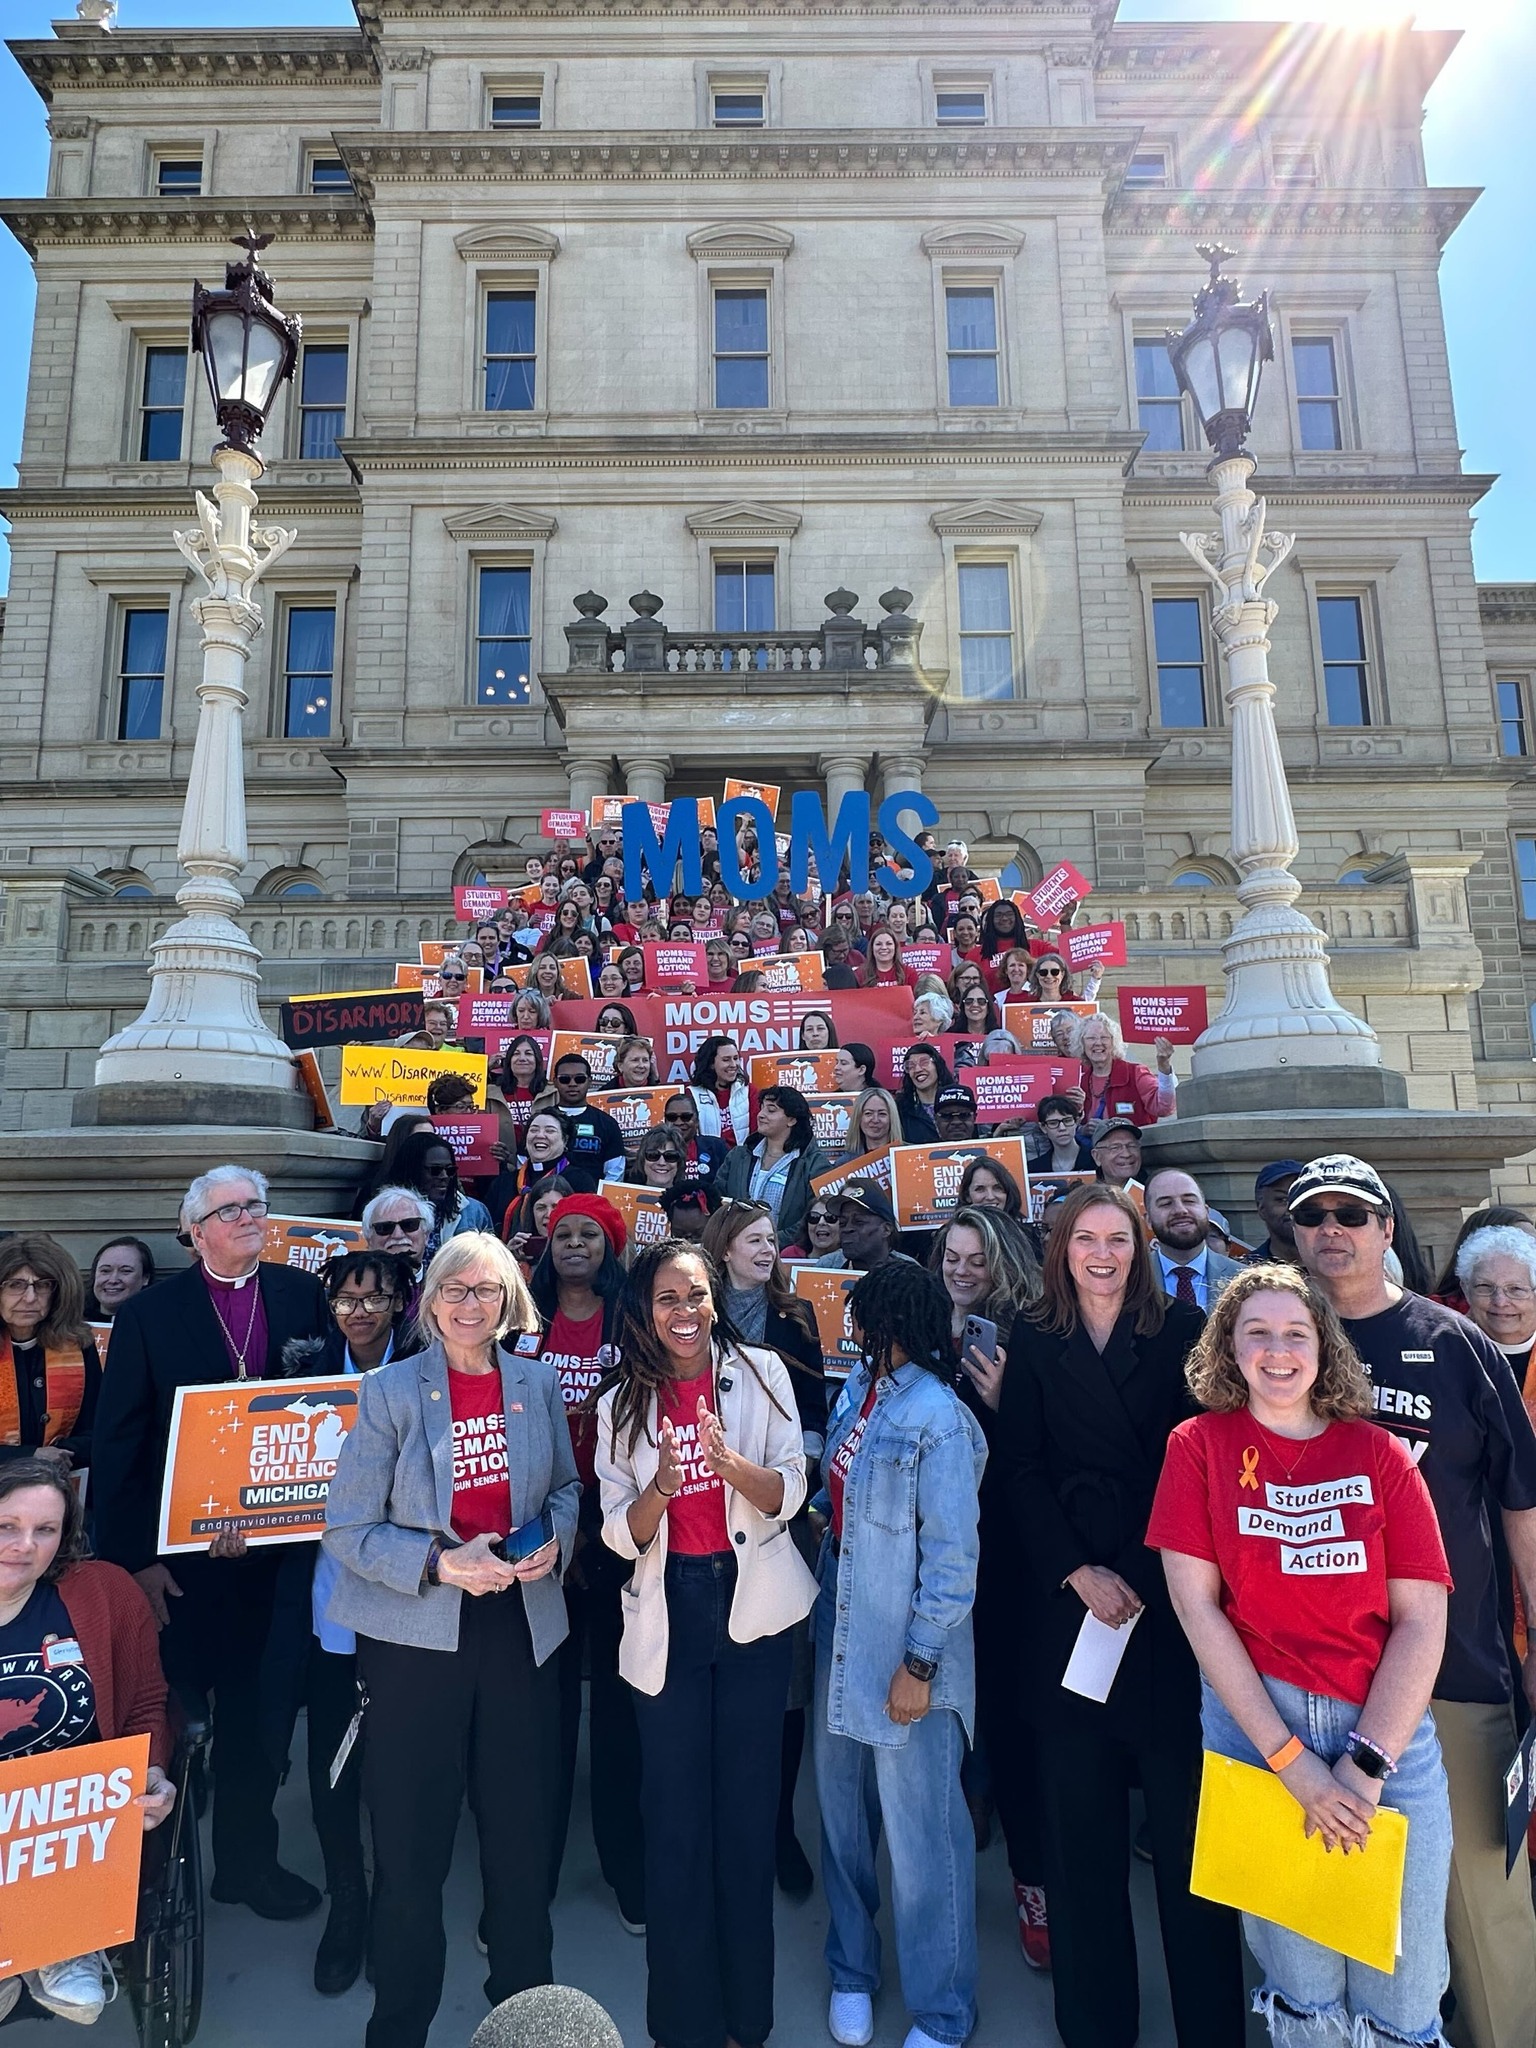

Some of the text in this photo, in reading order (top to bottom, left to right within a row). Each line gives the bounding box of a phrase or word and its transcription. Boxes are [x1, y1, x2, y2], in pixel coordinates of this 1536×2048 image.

[622, 790, 940, 902] MOMS
[1034, 869, 1069, 904] STUDENTS
[466, 891, 501, 899] STUDENTS
[1036, 886, 1064, 916] DEMAND
[1051, 887, 1078, 916] ACTION
[463, 900, 491, 908] DEMAND
[1068, 932, 1096, 945] MOMS
[1070, 938, 1108, 952] DEMAND
[902, 949, 927, 957] MOMS
[1071, 946, 1104, 959] ACTION
[656, 957, 694, 965] DEMAND
[657, 964, 691, 972] ACTION
[1132, 997, 1167, 1006] MOMS
[665, 1000, 771, 1026] MOMS
[1133, 1006, 1182, 1016] DEMAND
[1134, 1016, 1176, 1026] ACTION
[582, 1049, 605, 1058] END
[589, 1058, 604, 1067] UN
[778, 1069, 802, 1078] END
[778, 1077, 801, 1087] GUN
[976, 1076, 1013, 1086] MOMS
[976, 1085, 1028, 1095] DEMAND
[976, 1094, 1022, 1104] ACTION
[609, 1106, 634, 1116] END
[933, 1165, 965, 1178] END
[637, 1210, 668, 1225] END
[635, 1223, 666, 1236] GUN
[288, 1245, 328, 1261] END
[541, 1351, 581, 1370] OMS
[452, 1413, 499, 1438] OMS
[252, 1422, 311, 1447] END
[453, 1432, 508, 1458] EMAN
[249, 1443, 308, 1466] GUN
[249, 1460, 337, 1483] VIOLENC
[454, 1471, 509, 1492] GUN SENSE IN
[683, 1478, 720, 1495] SENSE IN
[246, 1482, 330, 1505] MICHIGA
[1275, 1482, 1364, 1509] Students
[1248, 1512, 1333, 1538] Demand
[1289, 1549, 1360, 1570] Action
[0, 1767, 133, 1834] WNERS
